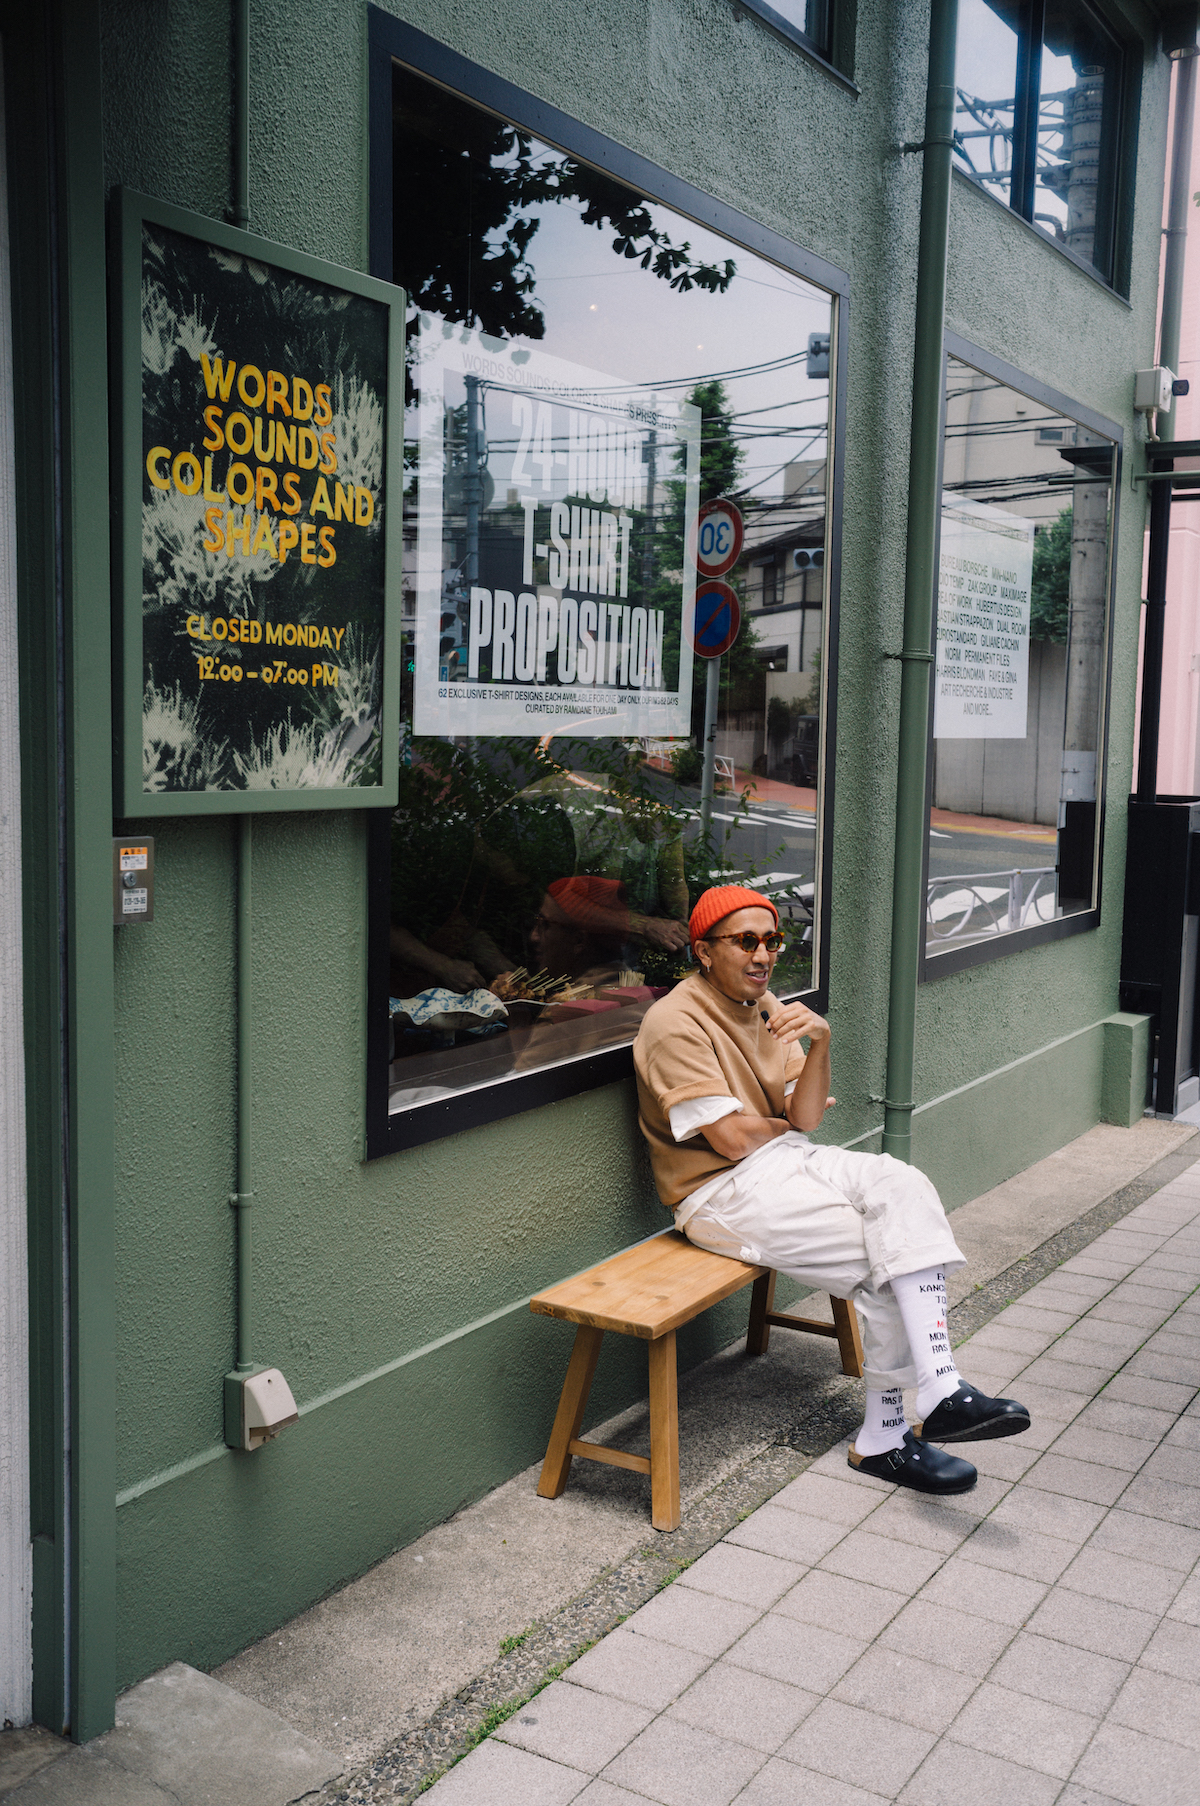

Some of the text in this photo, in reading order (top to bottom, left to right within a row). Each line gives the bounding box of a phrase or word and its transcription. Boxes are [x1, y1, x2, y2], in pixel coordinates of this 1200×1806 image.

[462, 352, 505, 379] WORDS
[506, 366, 550, 392] SOUNDS
[200, 353, 333, 427] WORDS
[202, 405, 338, 475] SOUNDS
[511, 395, 643, 512] 24-HOUR
[146, 446, 374, 527] COLORS AND
[203, 507, 337, 568] SHAPES
[521, 494, 633, 598] T-SHIRT
[941, 554, 962, 571] BUREAU
[963, 560, 988, 578] BORSCHE
[949, 575, 964, 589] TEMP
[968, 579, 979, 593] ZAK
[979, 582, 997, 597] GROUP
[956, 595, 973, 610] WORK
[976, 598, 1003, 615] HUBERTUS
[1003, 604, 1022, 619] DESIGN
[186, 615, 345, 651] CLOSED MONDAY
[960, 613, 993, 631] STRAPPAZON
[1011, 622, 1026, 636] ROOM
[468, 586, 664, 688] PROPOSITION
[945, 647, 1010, 667] NORM PERMANENT FILES
[197, 656, 243, 682] 12:00
[262, 660, 308, 685] 07:00
[312, 663, 339, 688] PM
[957, 665, 985, 681] BLONDMAN
[438, 688, 447, 698] 62
[448, 688, 487, 699] EXCLUSIVE
[488, 690, 514, 700] T-SHIRT
[515, 691, 544, 702] DESIGNS,
[545, 692, 561, 701] EACH
[562, 692, 592, 703] AVAILABLE
[593, 694, 604, 703] FOR
[605, 694, 617, 704] ONE
[617, 695, 628, 704] DAY
[941, 683, 951, 696] ART
[952, 683, 983, 698] RECHERCHE
[988, 687, 1013, 700] INDUSTRIE
[525, 703, 617, 715] CURATED BY RAMDANE TOUHAMI
[963, 702, 973, 715] AND
[882, 1396, 897, 1405] RAS
